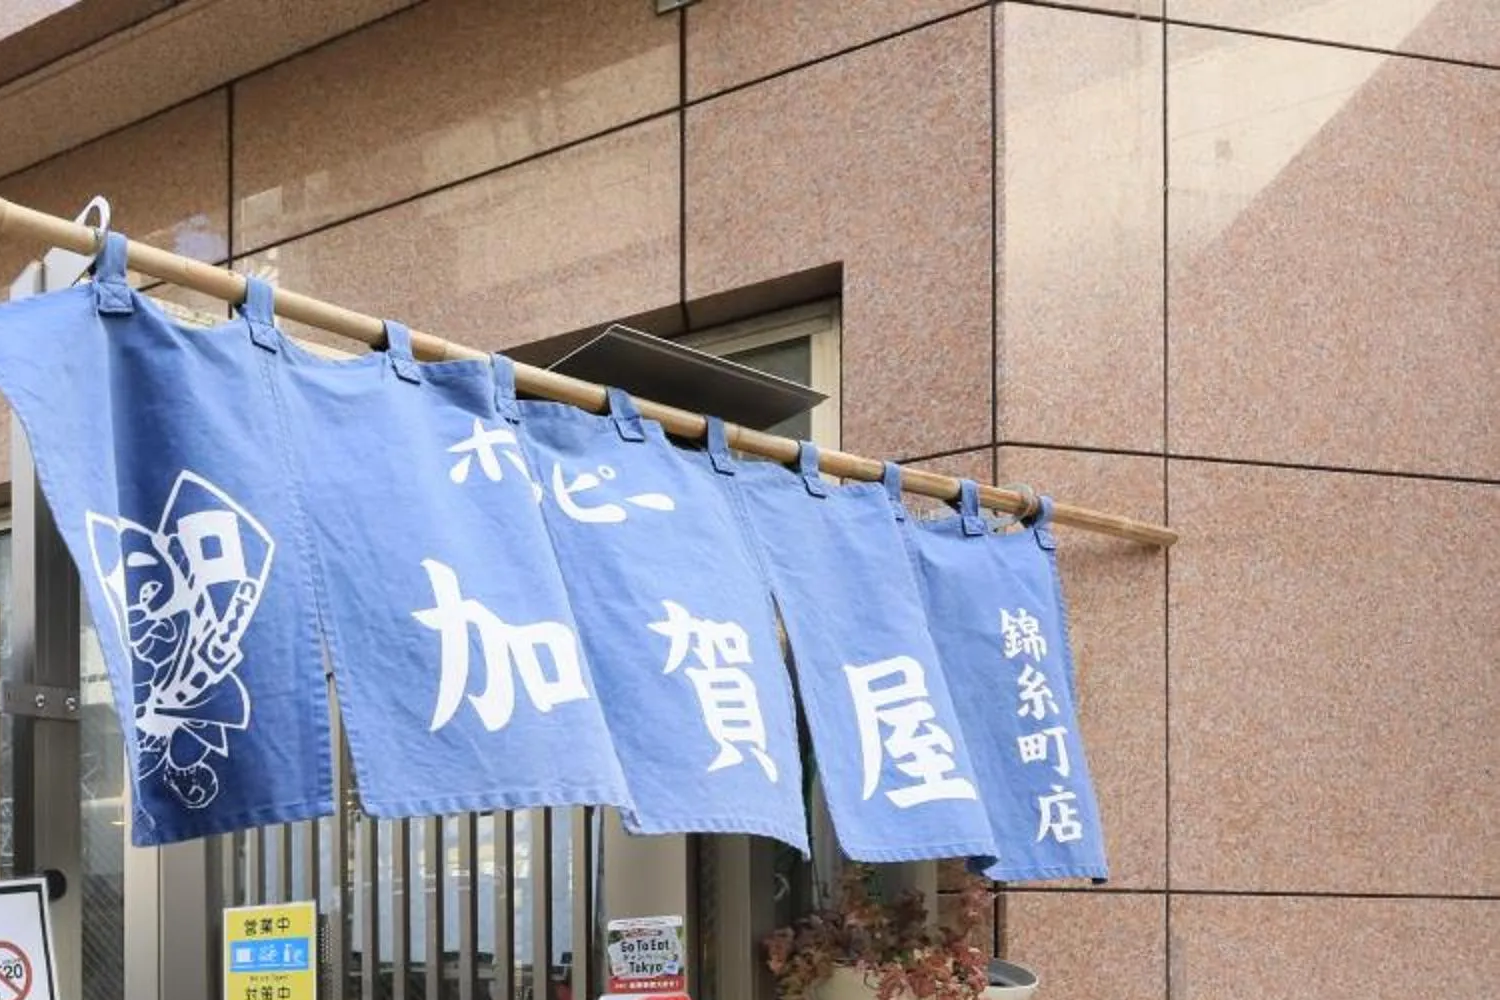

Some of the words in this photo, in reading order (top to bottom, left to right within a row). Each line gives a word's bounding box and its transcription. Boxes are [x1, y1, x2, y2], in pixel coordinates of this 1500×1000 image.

[448, 416, 675, 523] ホピー
[413, 558, 978, 808] 加賀屋
[1000, 608, 1083, 843] 錦糸町店
[243, 916, 291, 937] 営業中
[3, 963, 23, 981] 20
[628, 961, 662, 975] Tokyo
